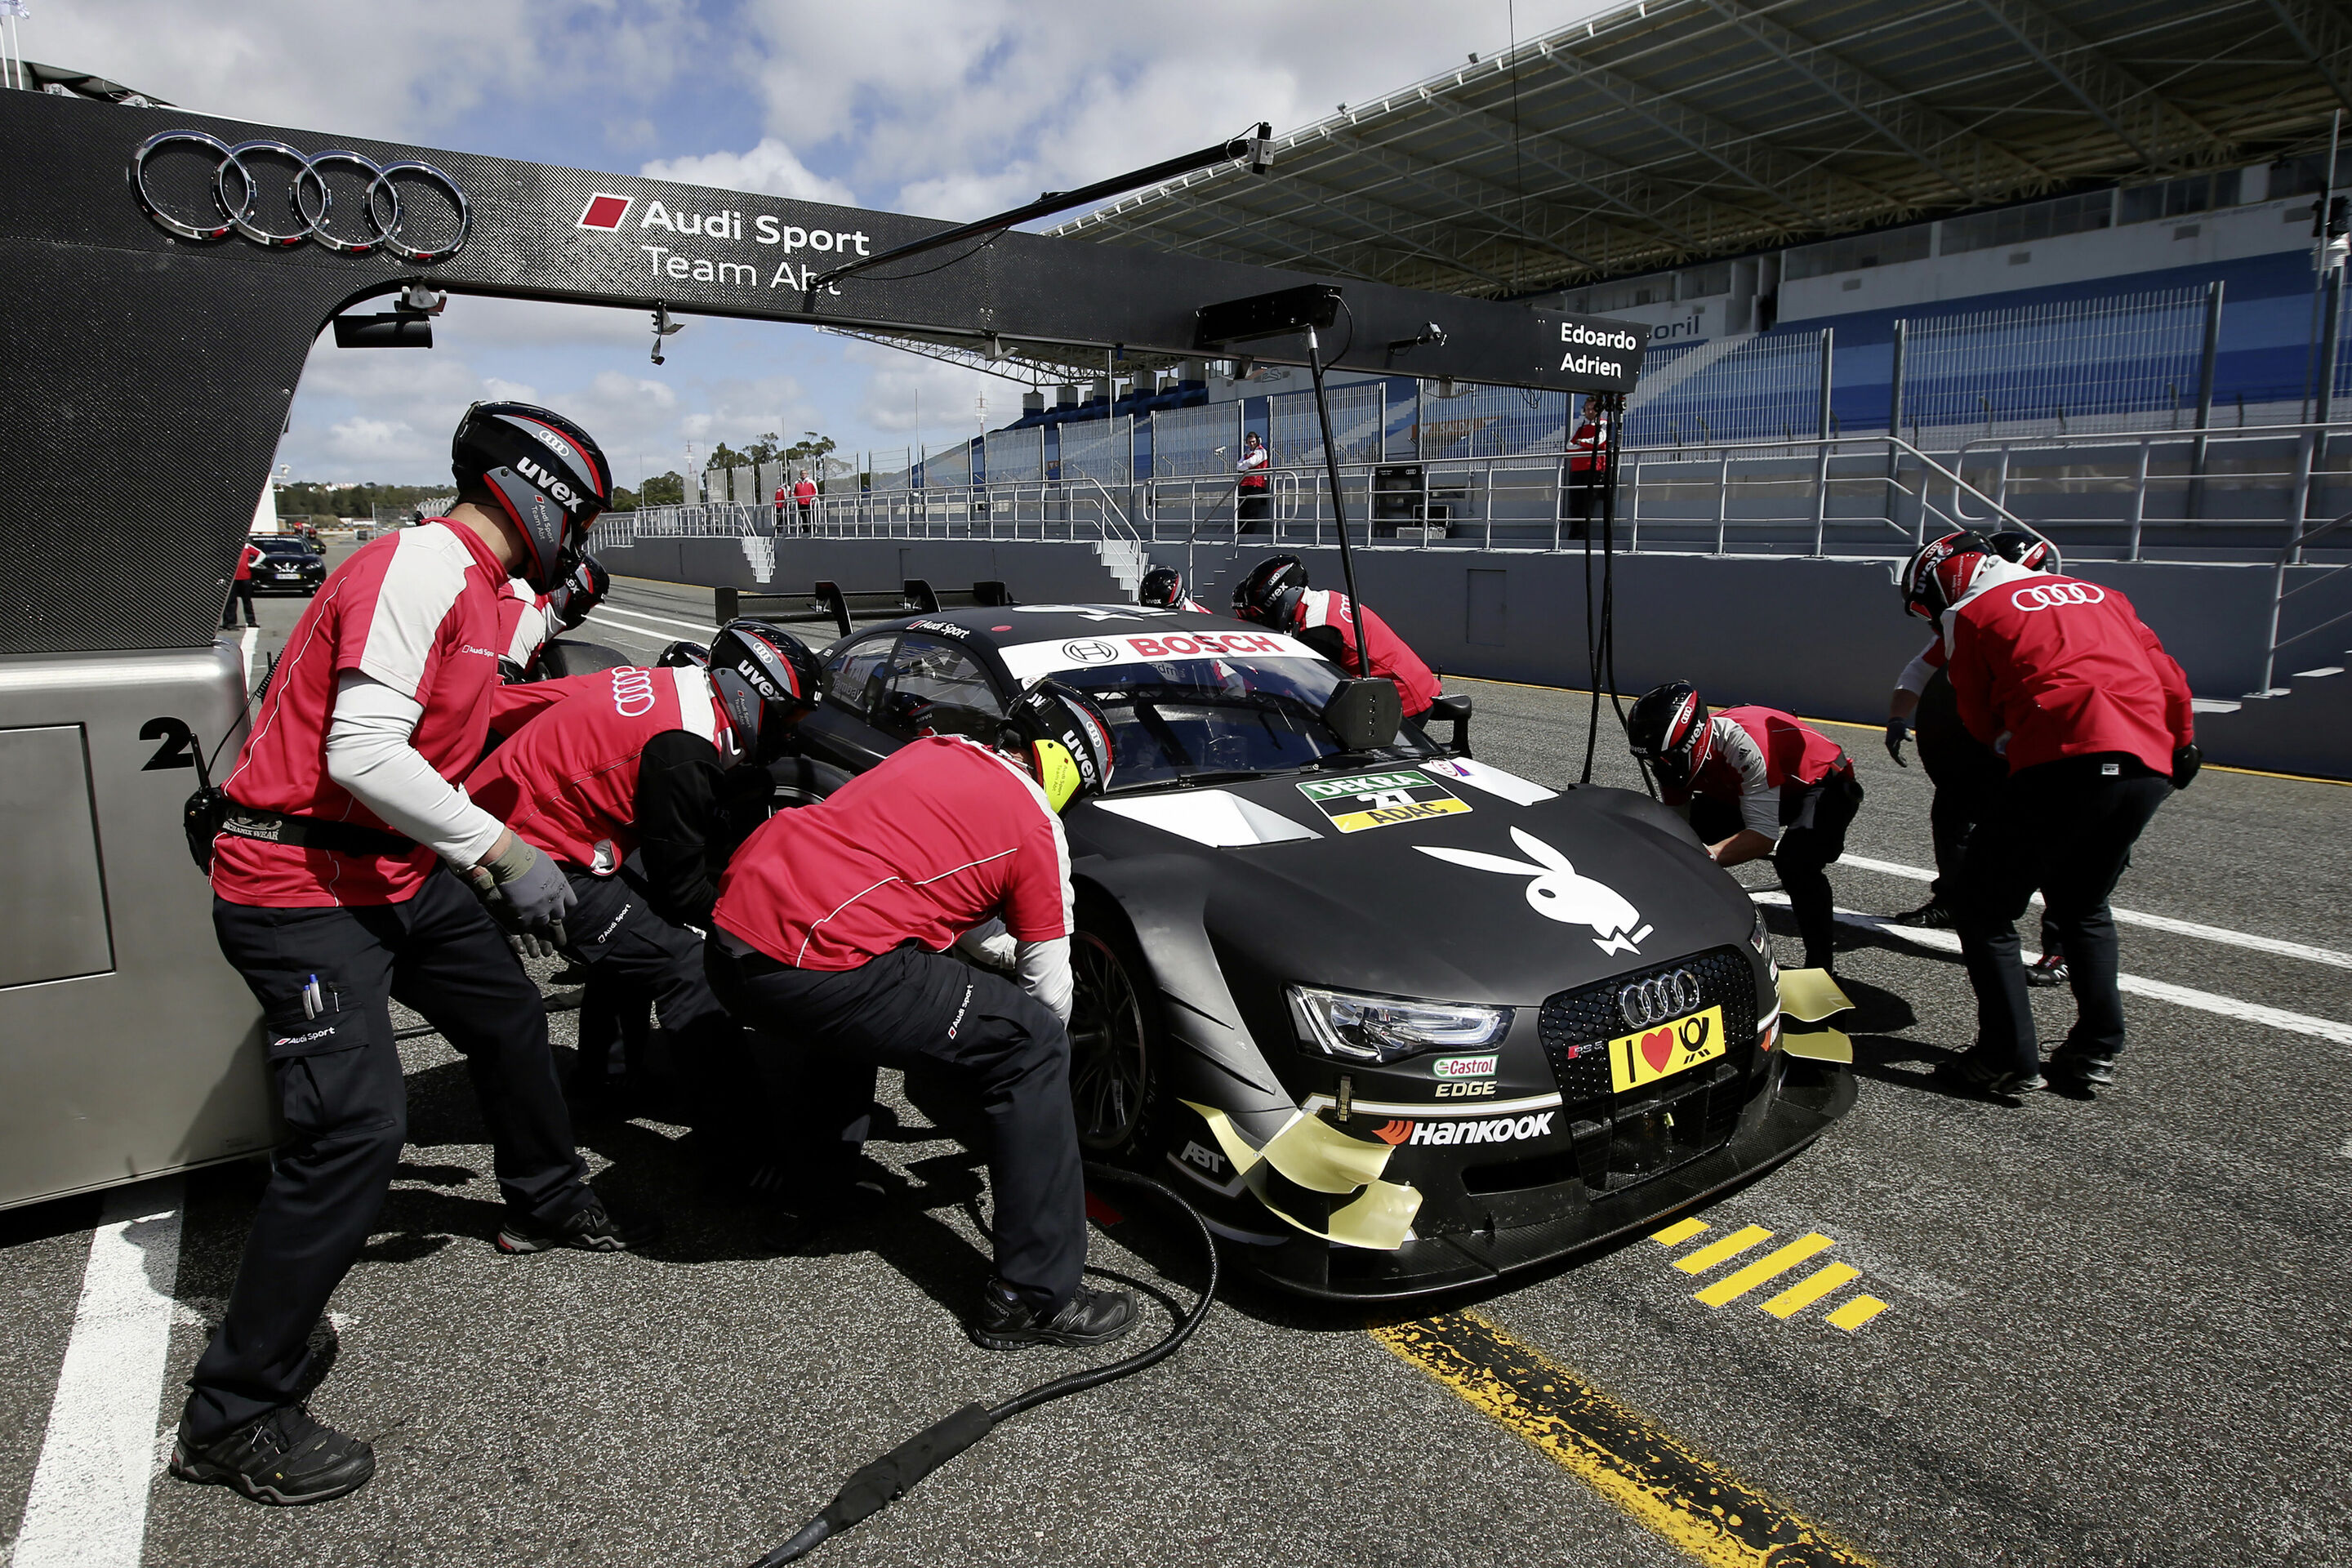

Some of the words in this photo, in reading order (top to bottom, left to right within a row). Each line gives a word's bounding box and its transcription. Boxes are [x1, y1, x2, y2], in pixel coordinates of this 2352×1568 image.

[640, 201, 742, 240] Audi
[755, 215, 870, 256] Sport
[641, 245, 757, 287] Team
[1561, 322, 1637, 350] Edoardo
[1650, 315, 1699, 340] oril
[1560, 353, 1622, 378] Adrien
[516, 456, 585, 514] uvex
[531, 506, 541, 526] Team
[539, 504, 550, 522] Audi
[544, 522, 555, 543] Sport
[1264, 581, 1290, 608] uvex
[919, 620, 947, 630] Audi
[940, 623, 971, 639] Sport
[1125, 635, 1285, 657] BOSCH
[737, 659, 786, 702] uvex
[139, 716, 194, 771] 2
[1682, 719, 1705, 753] uvex
[1062, 729, 1098, 789] uvex
[1307, 773, 1428, 796] DEKRA
[1366, 803, 1448, 824] ADAC
[253, 830, 279, 840] WEAR
[604, 921, 617, 938] Audi
[615, 903, 632, 923] Sport
[952, 1008, 965, 1028] Audi
[962, 984, 974, 1008] Sport
[288, 1034, 307, 1045] Audi
[307, 1027, 336, 1040] Sport
[1450, 1058, 1494, 1076] Castrol
[1626, 1040, 1636, 1084] I
[1435, 1080, 1498, 1098] EDGE
[1180, 1140, 1219, 1173] ABT
